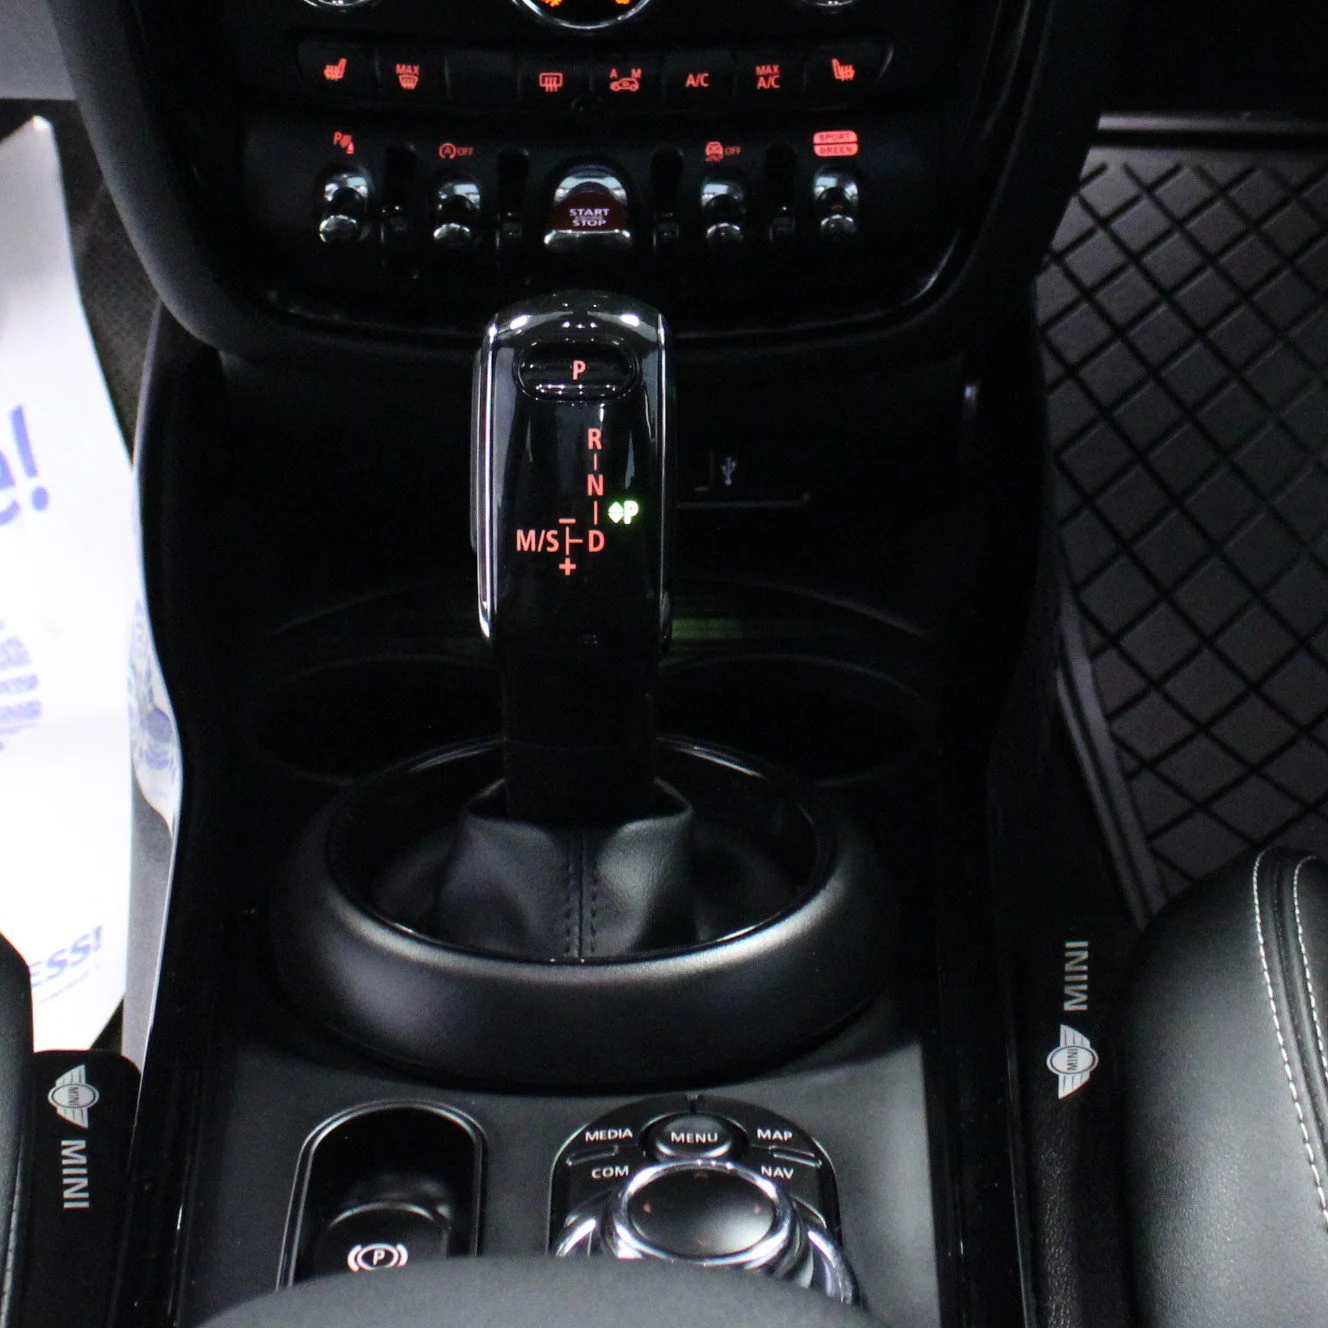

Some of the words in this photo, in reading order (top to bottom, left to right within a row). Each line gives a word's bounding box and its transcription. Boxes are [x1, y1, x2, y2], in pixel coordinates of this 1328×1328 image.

[395, 63, 420, 75] MAX
[609, 68, 618, 79] A
[630, 68, 643, 79] M
[755, 64, 780, 76] MAX
[685, 73, 710, 88] A/C
[757, 75, 781, 90] A/C
[818, 132, 851, 141] SPORT
[819, 145, 853, 154] GREEN
[569, 208, 610, 216] START
[572, 219, 607, 227] STOP
[572, 360, 586, 380] P
[587, 428, 603, 450] R
[587, 474, 604, 496] N
[516, 529, 560, 553] M/S
[588, 530, 605, 552] D
[1063, 941, 1088, 1012] MINI
[585, 1128, 633, 1142] MEDIA
[671, 1132, 718, 1143] MENU
[757, 1128, 793, 1141] MAP
[61, 1140, 90, 1209] MINI
[591, 1165, 629, 1179] COM
[761, 1165, 794, 1180] NAV
